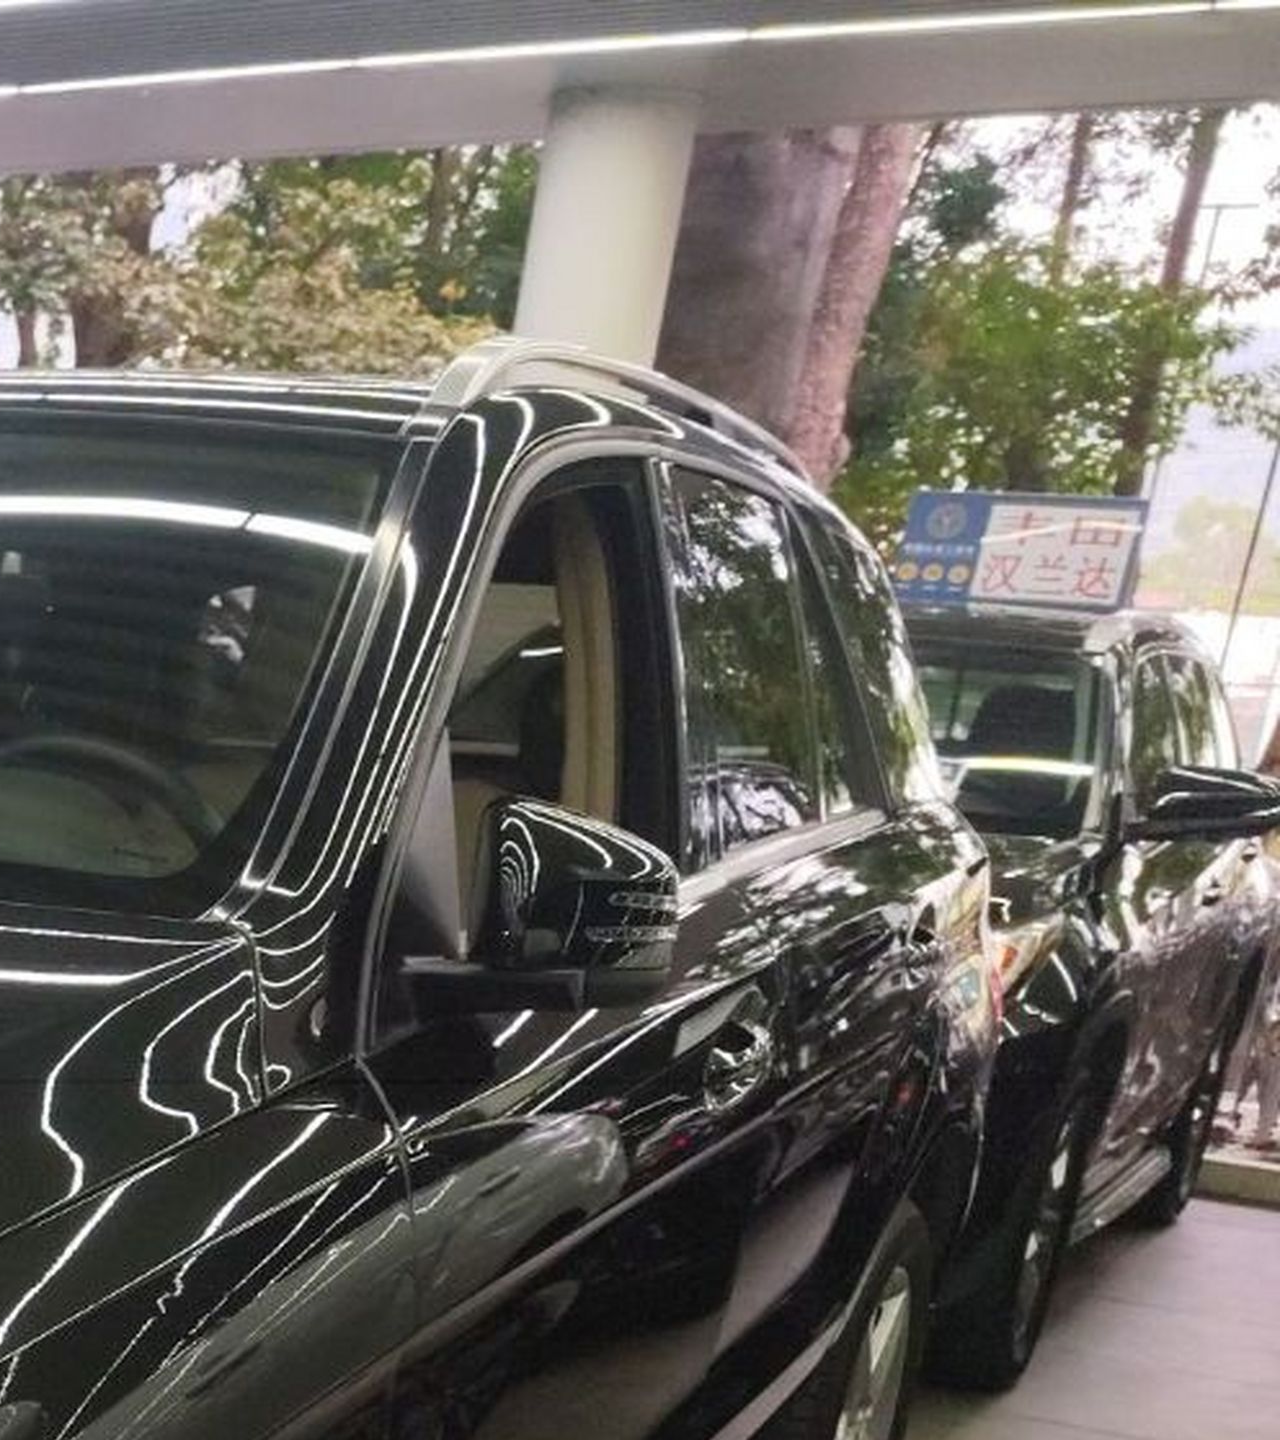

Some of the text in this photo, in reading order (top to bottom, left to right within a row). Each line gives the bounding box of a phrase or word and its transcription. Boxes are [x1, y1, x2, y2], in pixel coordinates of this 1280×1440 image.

[997, 511, 1127, 546] 丰田
[981, 554, 1116, 599] 汉兰达
